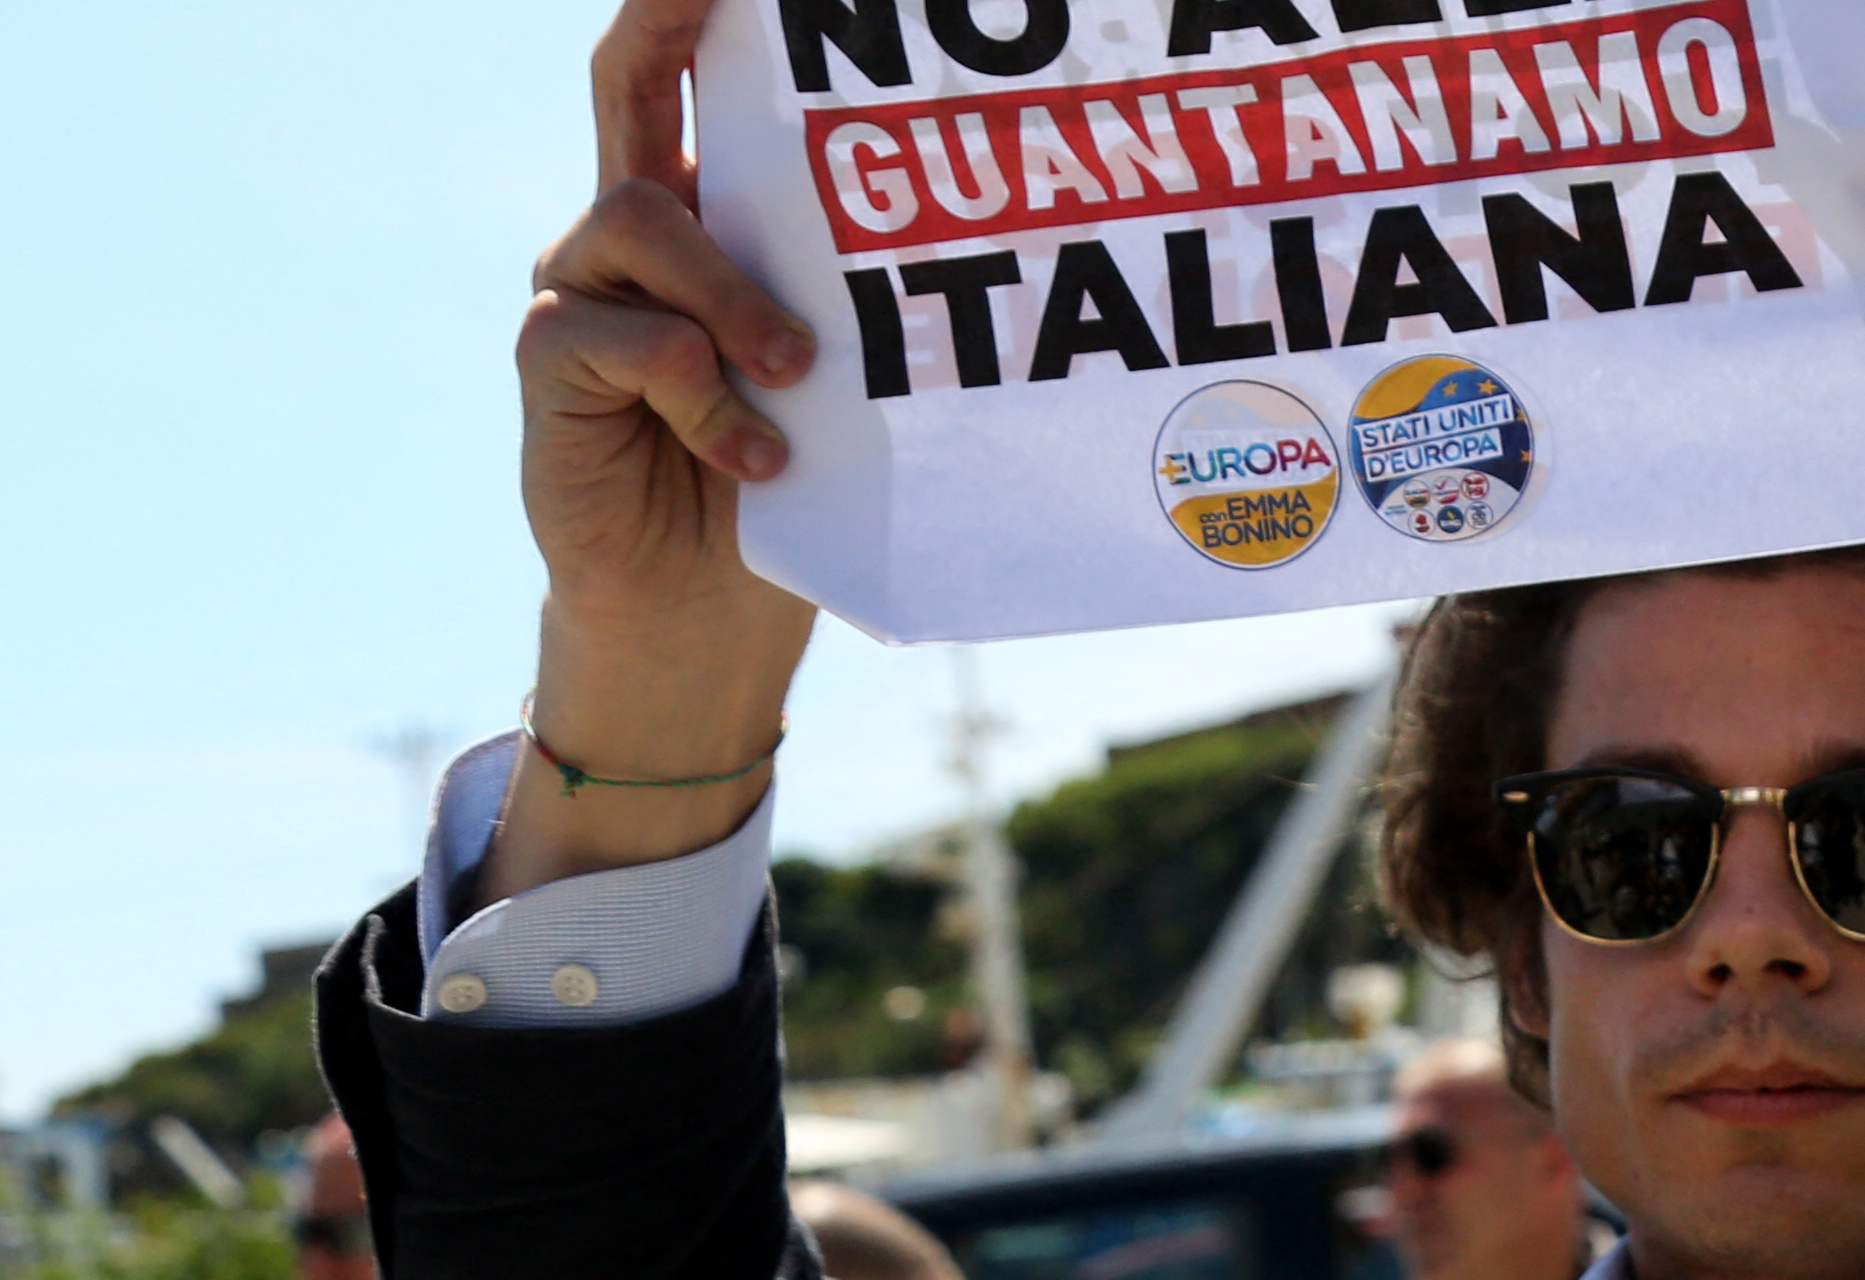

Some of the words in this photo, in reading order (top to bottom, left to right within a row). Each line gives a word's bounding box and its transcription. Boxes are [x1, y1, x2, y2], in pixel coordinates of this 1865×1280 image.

[823, 16, 1748, 235] GUANTANAMO
[843, 171, 1804, 400] ITALIANA
[1361, 414, 1431, 448] STATI
[1438, 398, 1510, 432] UNITI
[1367, 432, 1499, 478] D'EUROPA
[1226, 489, 1312, 521] EMMA
[1200, 513, 1314, 548] BONINO
